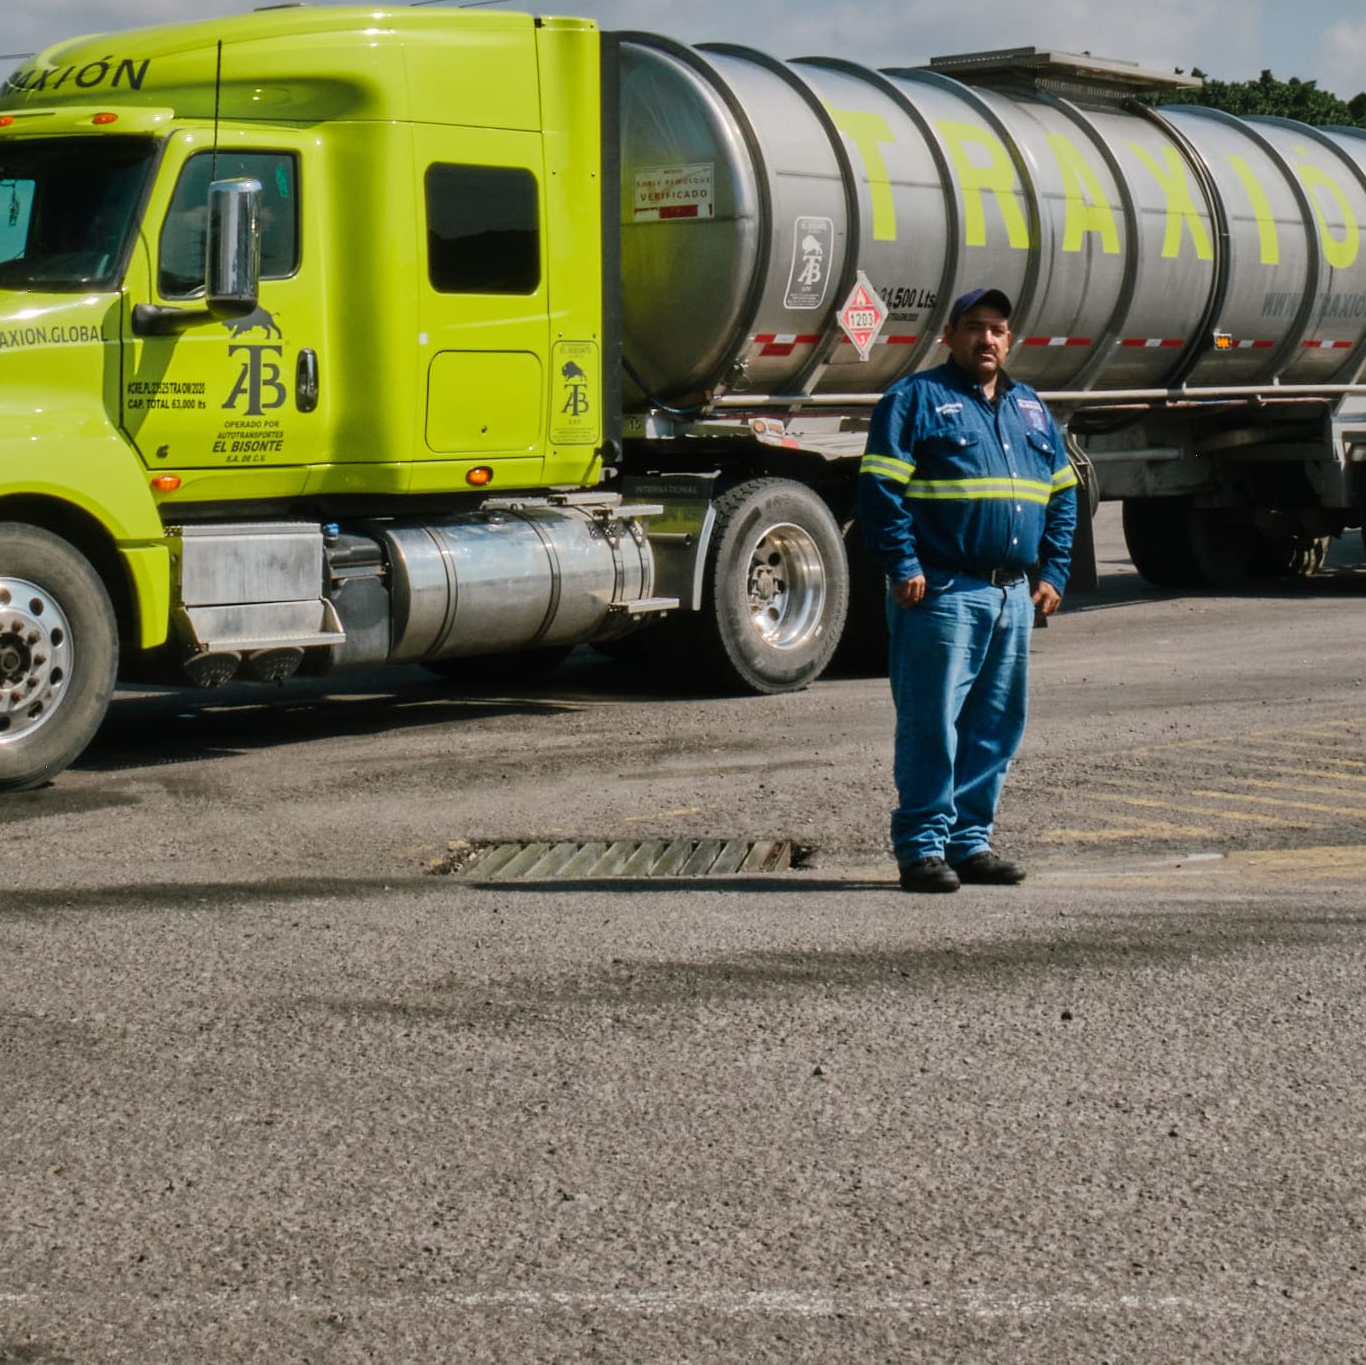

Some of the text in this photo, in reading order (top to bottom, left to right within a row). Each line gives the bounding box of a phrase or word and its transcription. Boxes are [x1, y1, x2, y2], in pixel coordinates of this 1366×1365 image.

[1, 55, 151, 96] AXIÓN
[639, 189, 708, 202] VERIFICADO
[850, 313, 874, 327] 1203
[128, 399, 145, 410] CAP.
[146, 399, 170, 410] TOTAL
[223, 420, 280, 429] OPERADO POR
[216, 430, 285, 440] AUTOTRANSPORTES
[212, 439, 285, 453] EL BISONTE
